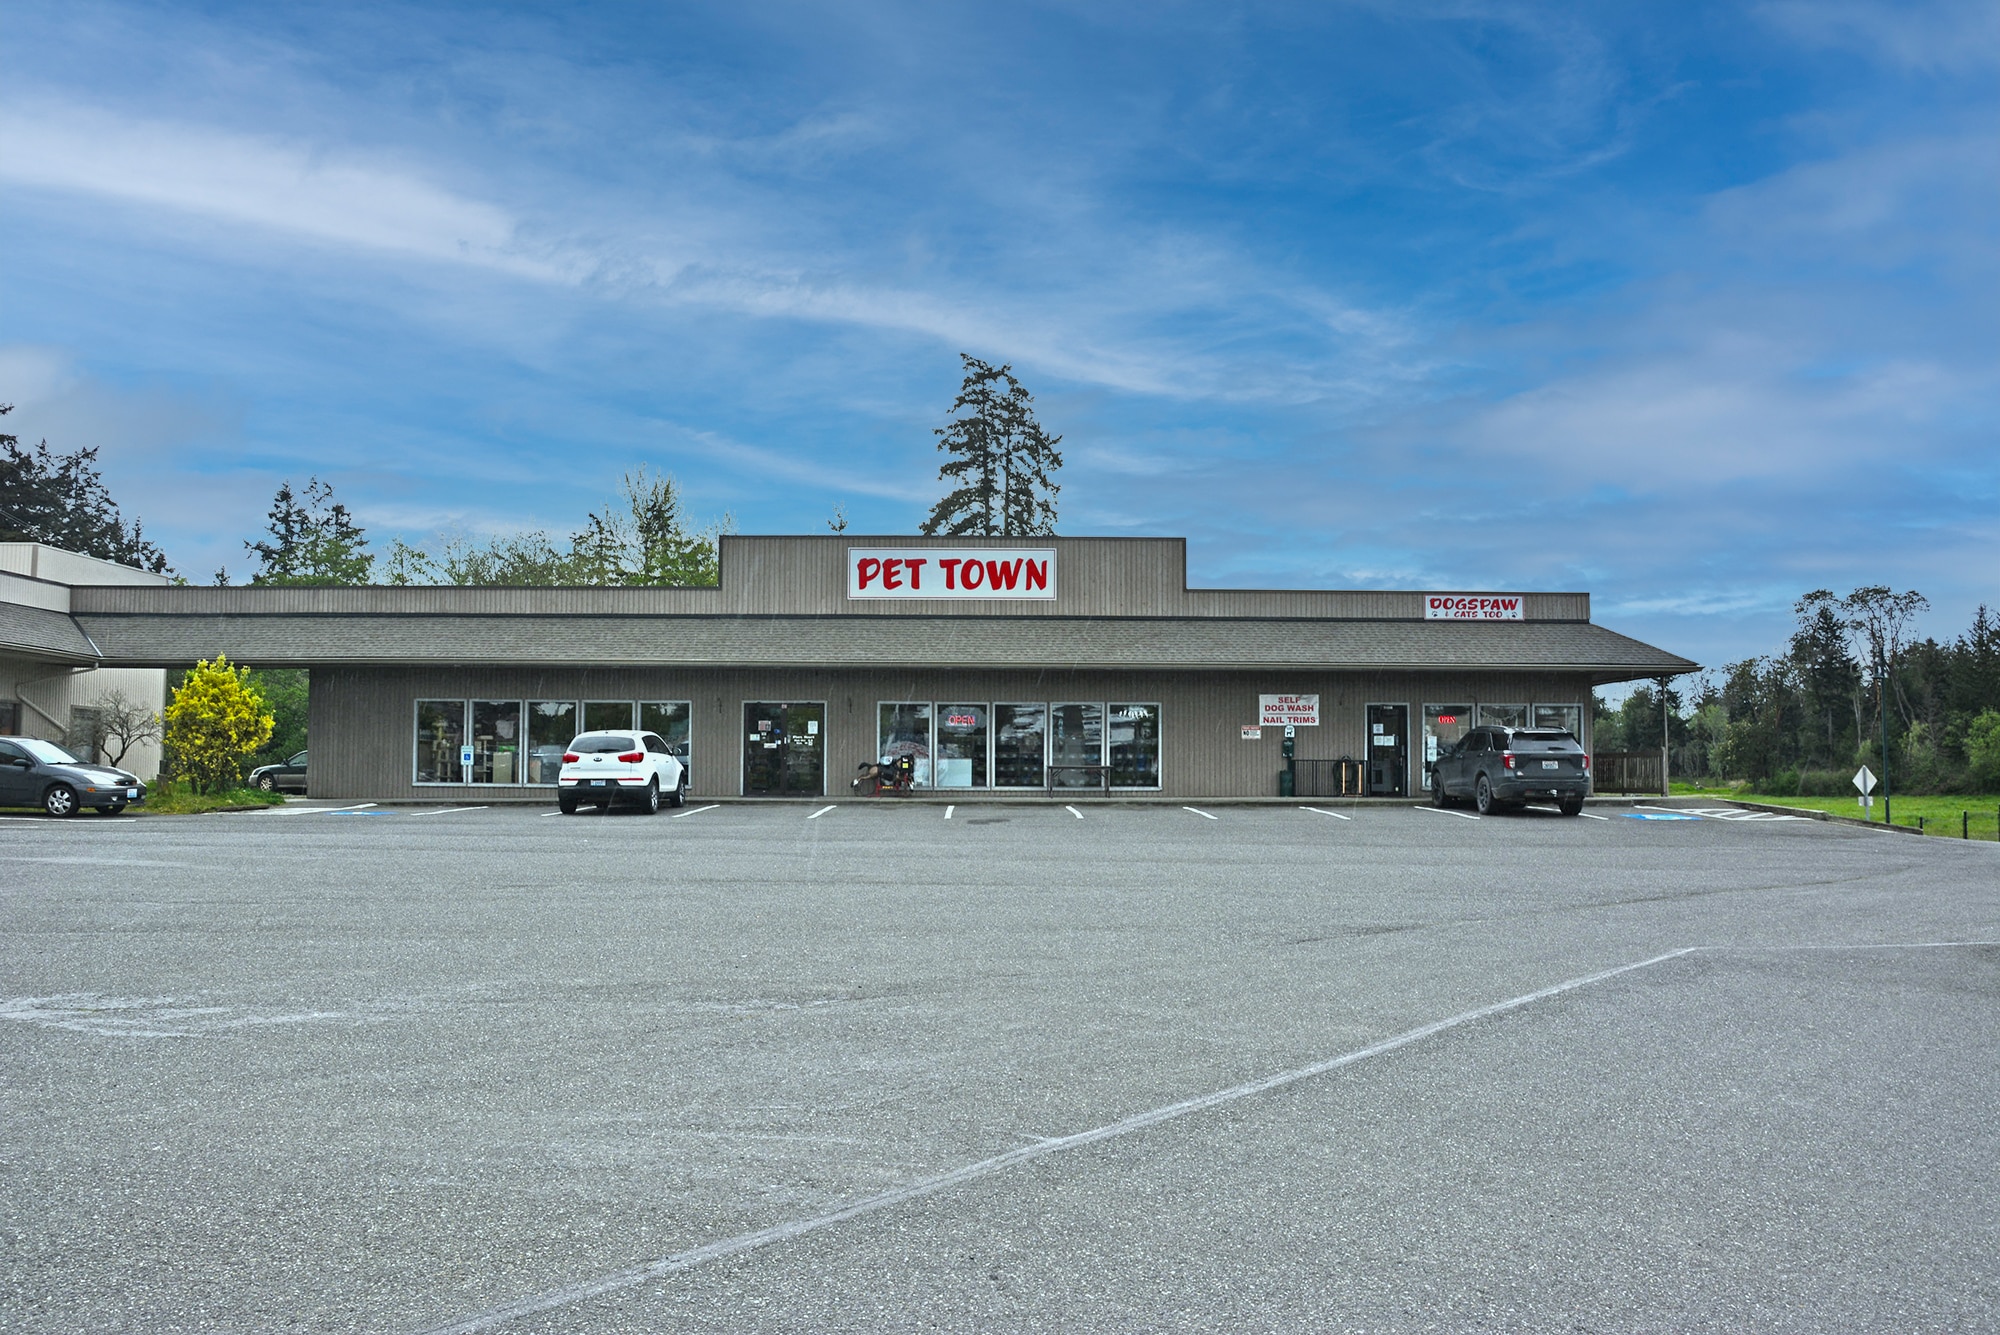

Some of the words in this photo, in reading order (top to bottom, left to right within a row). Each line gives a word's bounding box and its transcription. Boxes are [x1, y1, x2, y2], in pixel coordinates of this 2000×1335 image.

[857, 558, 927, 590] PET
[939, 558, 1047, 591] TOWN
[1430, 597, 1519, 611] DOGSPAW
[1278, 696, 1301, 704] SELF
[1264, 704, 1285, 712] DOG
[1287, 704, 1314, 712] WASH
[948, 715, 976, 726] OPEN
[1263, 716, 1285, 724] NAIL
[1287, 716, 1316, 724] TRIMS
[1438, 715, 1457, 725] OPEN
